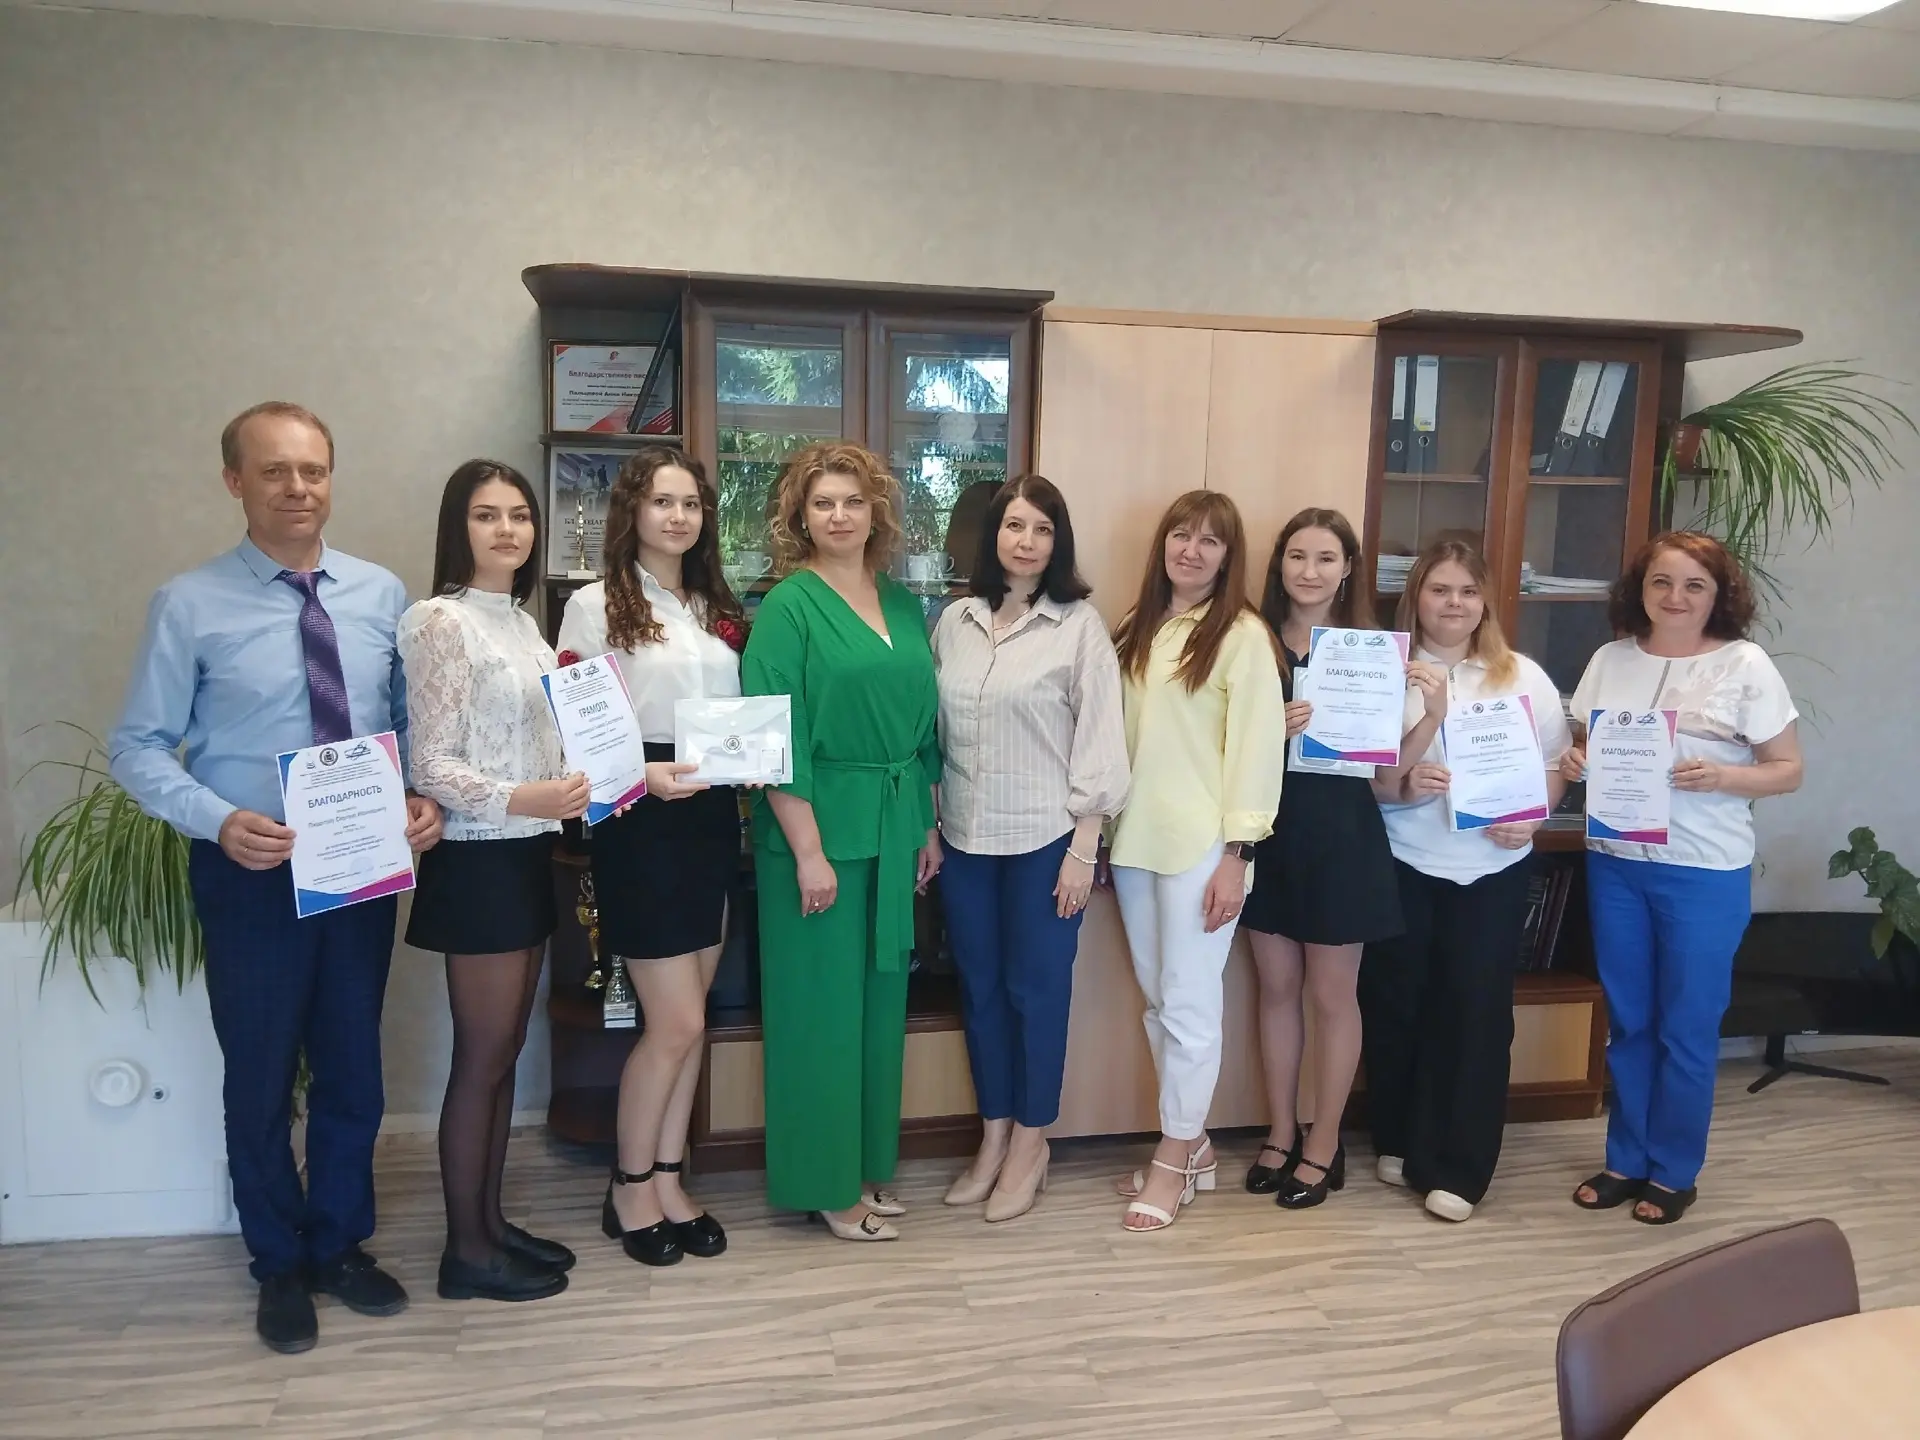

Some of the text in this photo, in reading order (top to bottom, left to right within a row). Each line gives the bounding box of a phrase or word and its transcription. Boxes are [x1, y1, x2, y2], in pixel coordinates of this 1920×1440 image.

[568, 370, 632, 379] Благодарственное
[1326, 668, 1388, 679] БЛАГОДАРНОСТЬ
[578, 700, 609, 719] ГРАМОТА
[1471, 732, 1508, 744] ГРАМОТА
[1601, 748, 1657, 757] БЛАГОДАРНОСТЬ
[307, 785, 383, 809] БЛАГОДАРНОСТЬ
